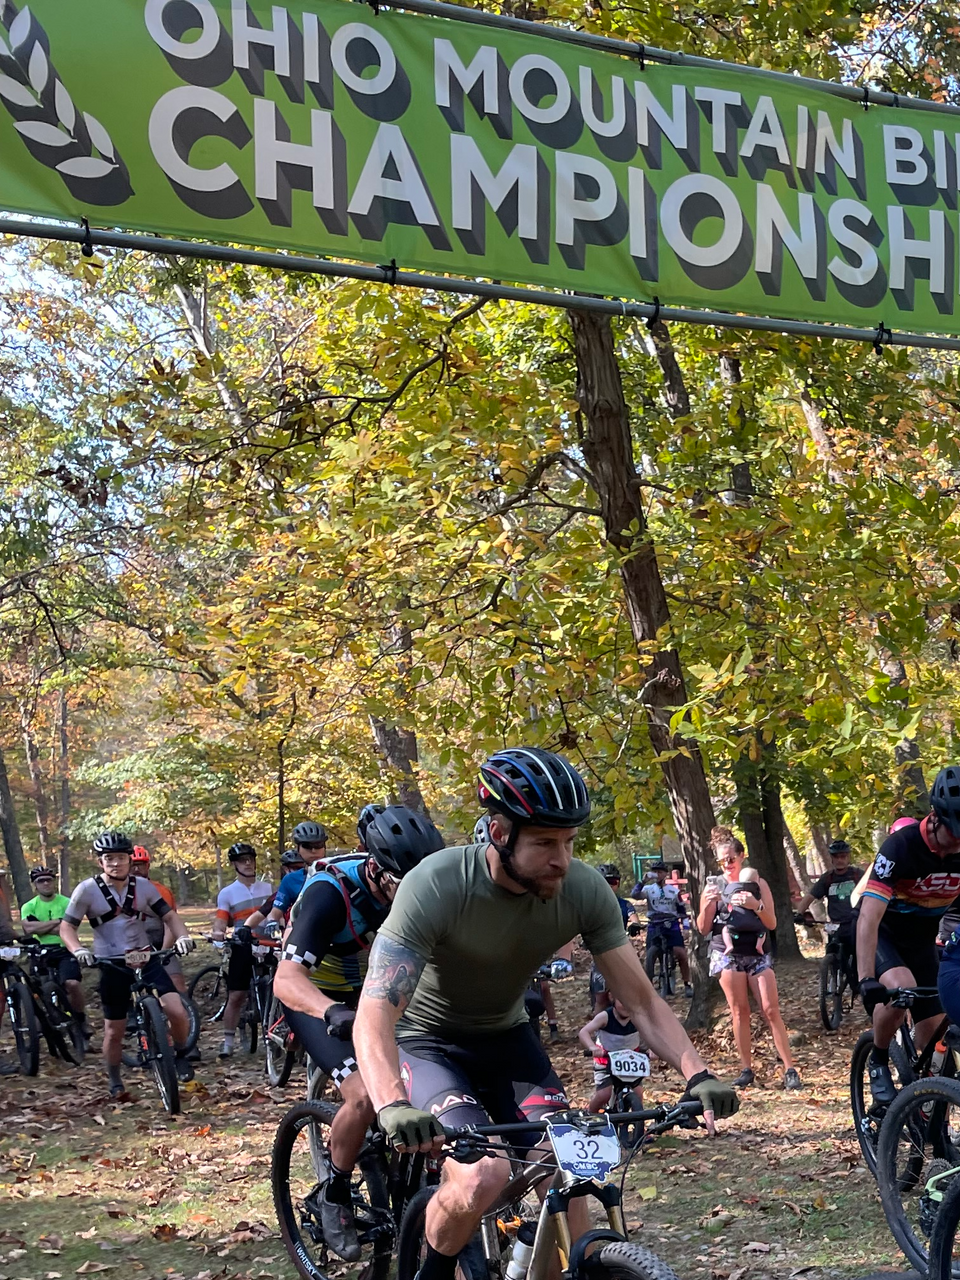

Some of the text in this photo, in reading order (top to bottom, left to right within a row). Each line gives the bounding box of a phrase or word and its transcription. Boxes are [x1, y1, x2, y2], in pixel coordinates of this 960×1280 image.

[145, 0, 398, 96] OHIO
[433, 38, 857, 180] MOUNTAIN
[614, 1060, 647, 1073] 9034
[573, 1140, 604, 1160] 32
[296, 1247, 317, 1276] WHISKY
